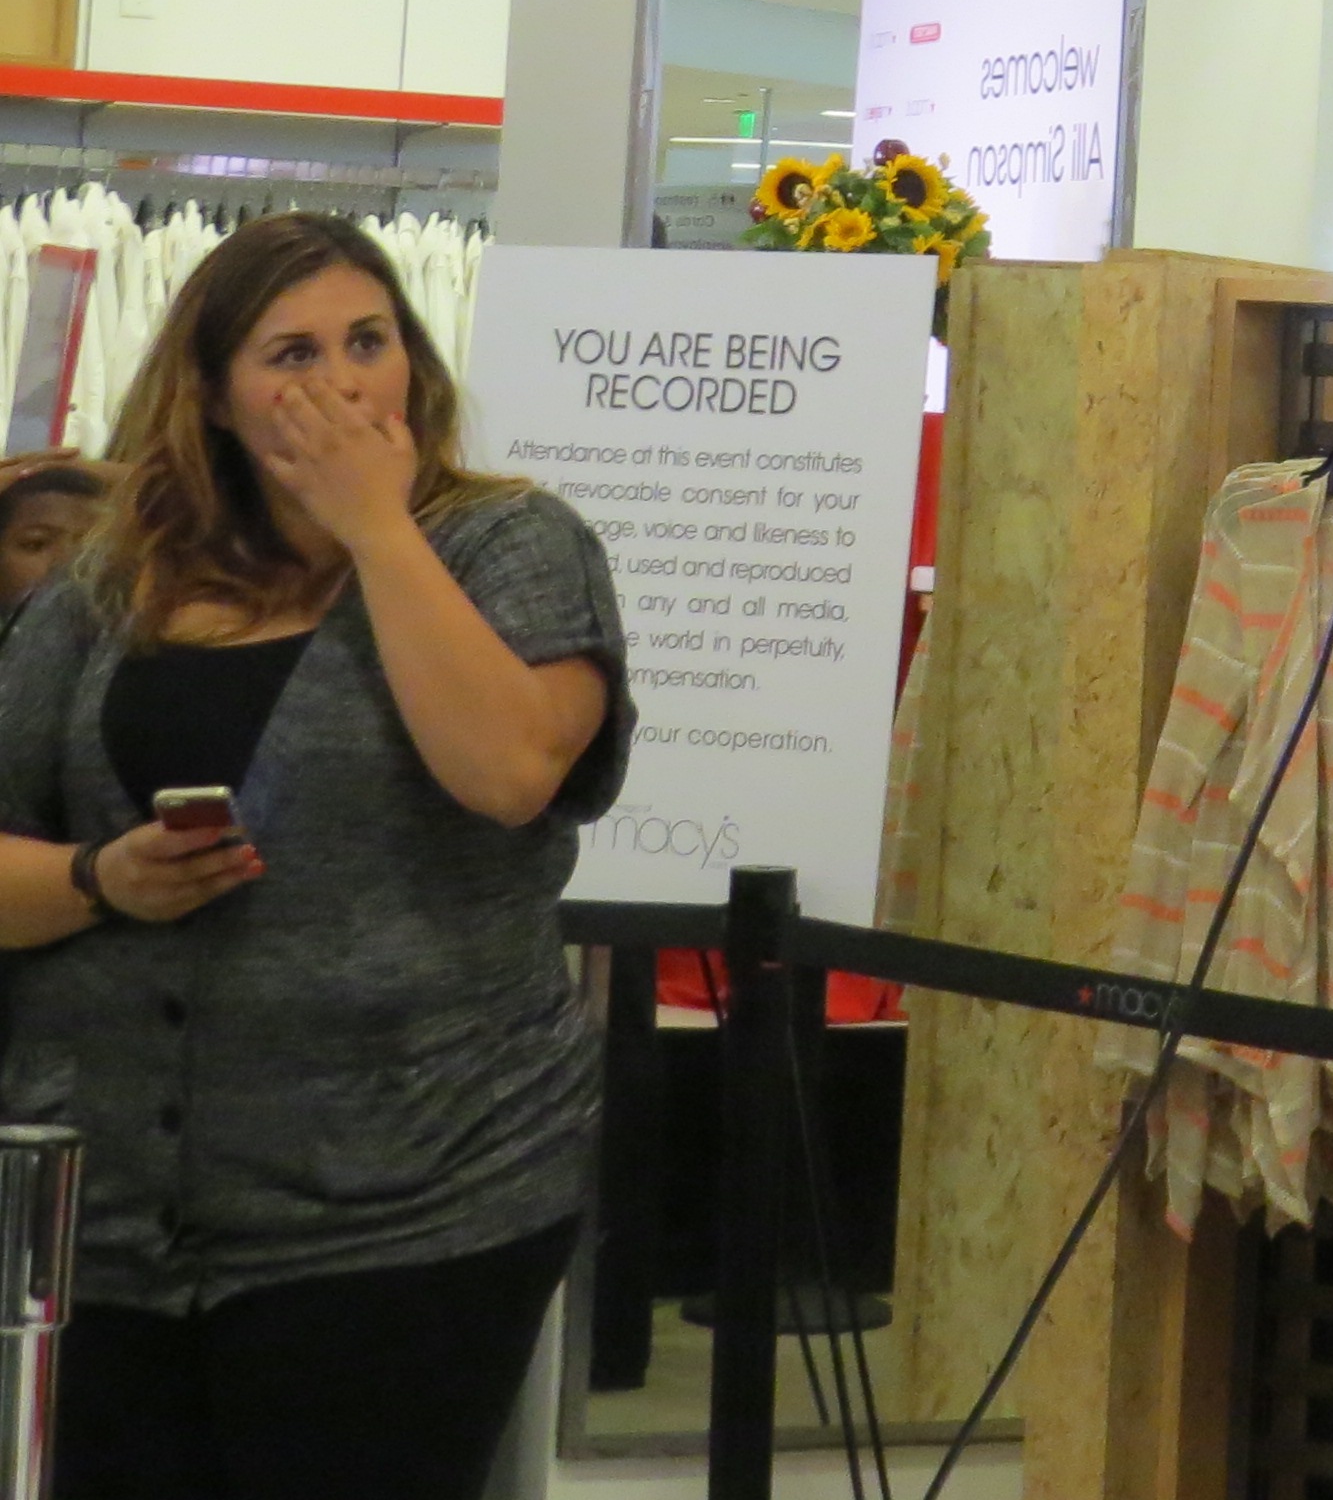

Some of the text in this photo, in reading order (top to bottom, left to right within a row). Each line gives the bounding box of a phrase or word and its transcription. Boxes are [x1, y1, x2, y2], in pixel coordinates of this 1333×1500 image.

[554, 327, 841, 373] YOU ARE BEING
[585, 374, 797, 415] RECORDED
[507, 439, 863, 474] Attendance at this event constitutes
[558, 477, 671, 502] irrevocable
[682, 486, 767, 505] consent
[776, 485, 803, 508] for
[814, 492, 860, 513] your
[644, 520, 698, 540] voice
[705, 522, 747, 542] and
[753, 522, 829, 547] likeness
[836, 526, 856, 548] to
[627, 555, 678, 576] used
[683, 557, 725, 578] and
[731, 561, 852, 584] reproduced
[638, 594, 676, 617] any
[688, 596, 731, 615] and
[743, 596, 766, 617] all
[777, 599, 849, 623] media,
[650, 629, 705, 650] world
[713, 630, 731, 652] in
[741, 635, 845, 663] perpetuity,
[633, 726, 832, 753] your cooperation.
